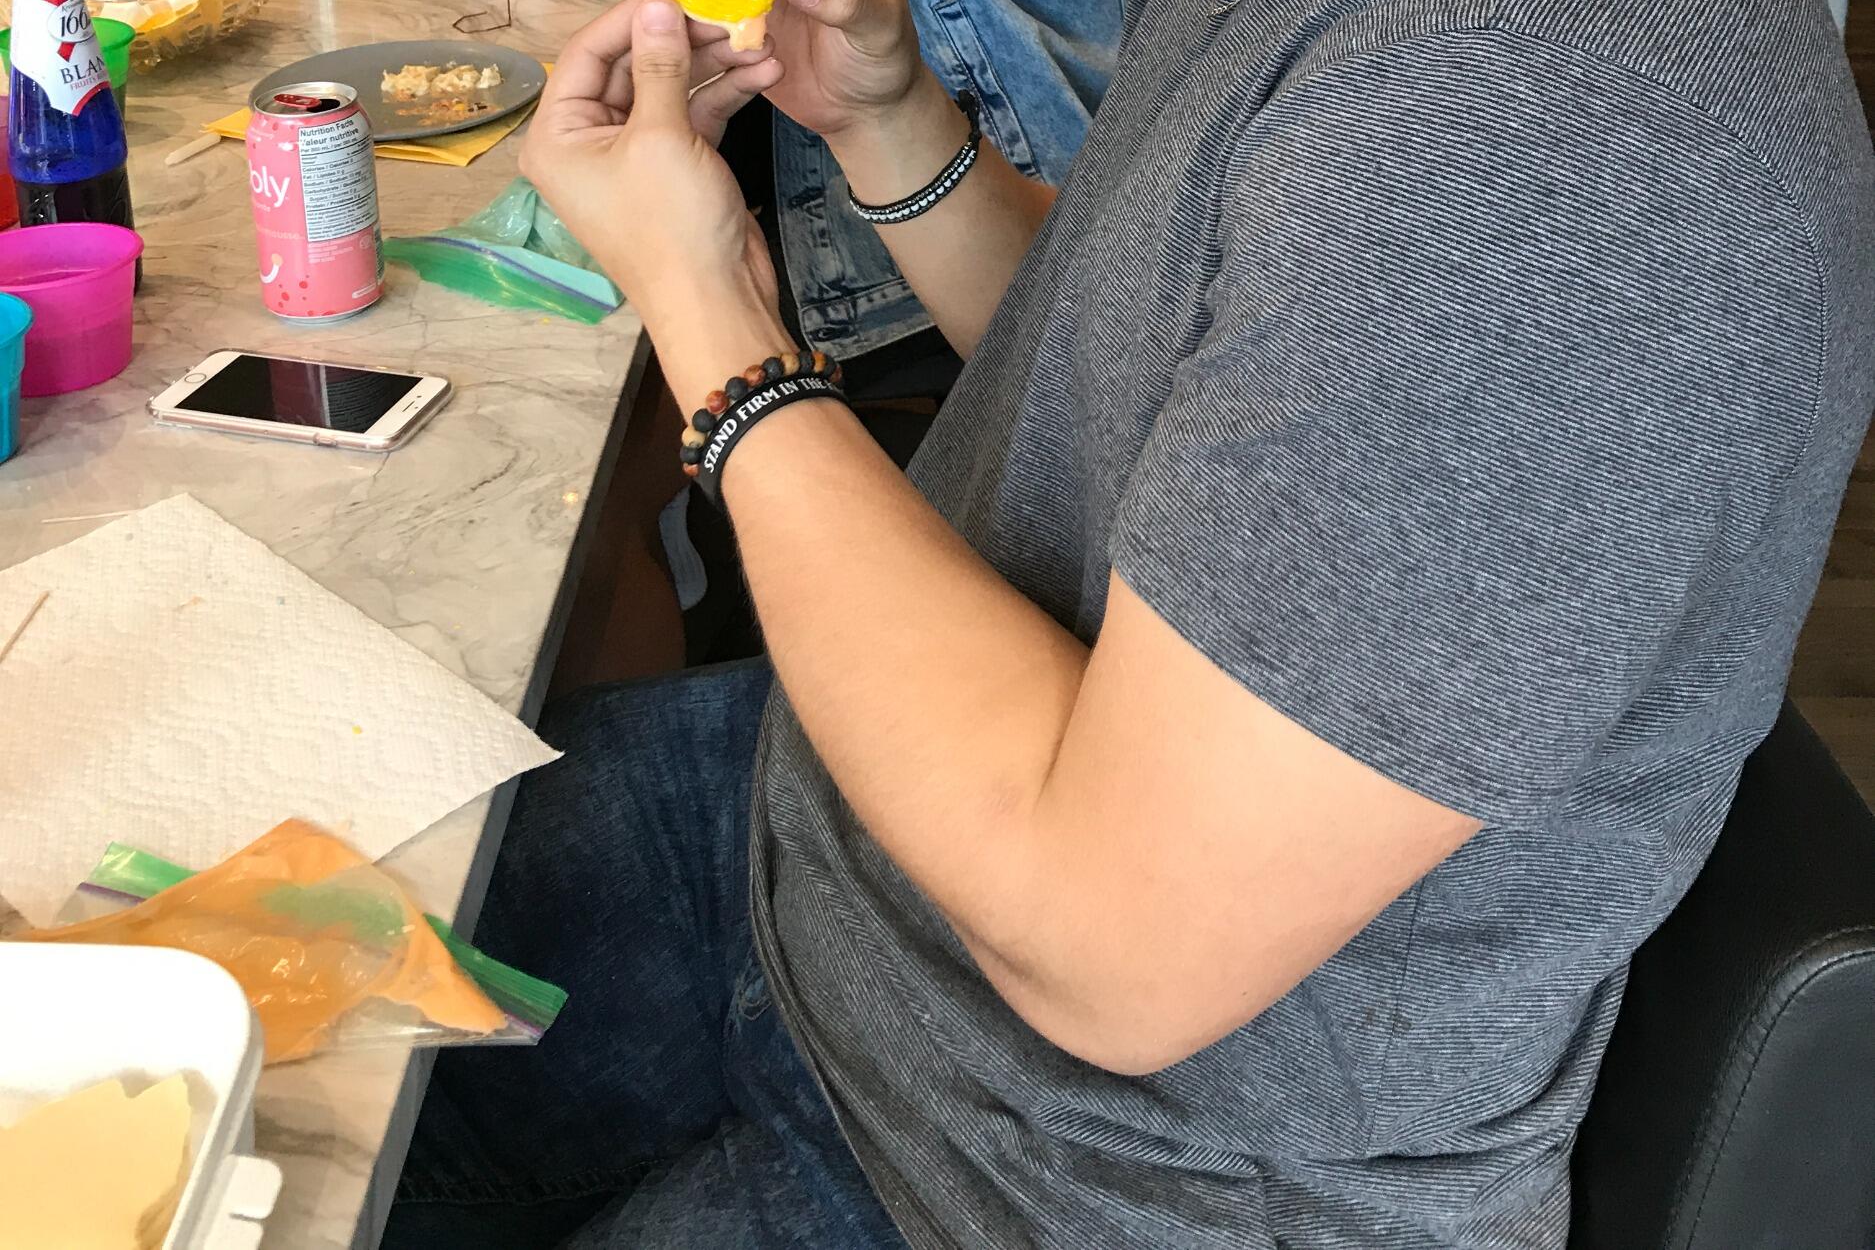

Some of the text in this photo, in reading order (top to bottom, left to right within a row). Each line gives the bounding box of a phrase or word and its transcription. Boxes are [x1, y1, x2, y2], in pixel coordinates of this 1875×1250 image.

[60, 6, 91, 37] 166
[300, 119, 354, 137] Nutrition Facts
[329, 128, 359, 142] nutritive
[703, 418, 738, 473] STAND
[736, 387, 781, 422] FIRM
[778, 380, 799, 395] IN
[800, 377, 827, 390] THE
